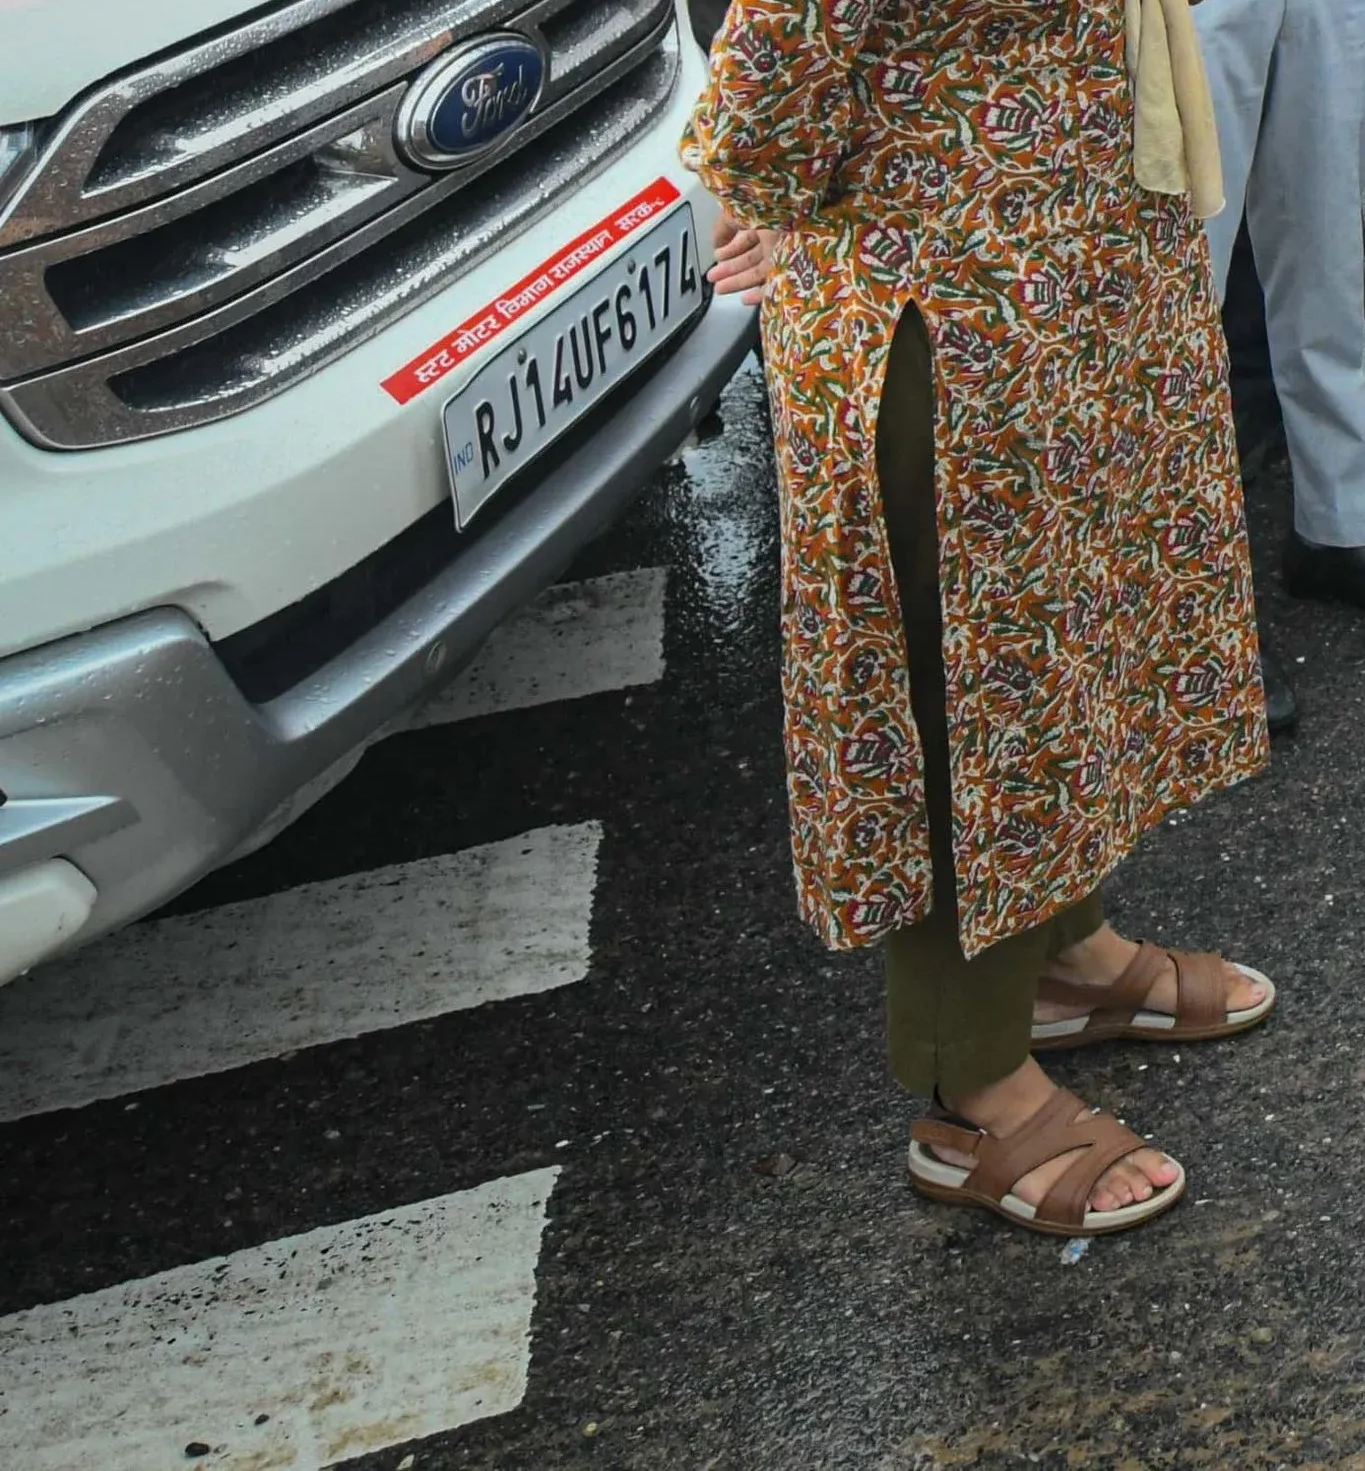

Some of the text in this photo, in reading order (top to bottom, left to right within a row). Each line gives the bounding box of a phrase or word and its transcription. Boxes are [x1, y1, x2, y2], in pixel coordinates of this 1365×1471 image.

[461, 62, 527, 139] Ford
[450, 317, 501, 354] मोटर
[496, 274, 554, 319] विभाग
[550, 229, 615, 279] राजस्थान
[475, 230, 697, 480] RJ14UF6174
[453, 442, 474, 476] IND
